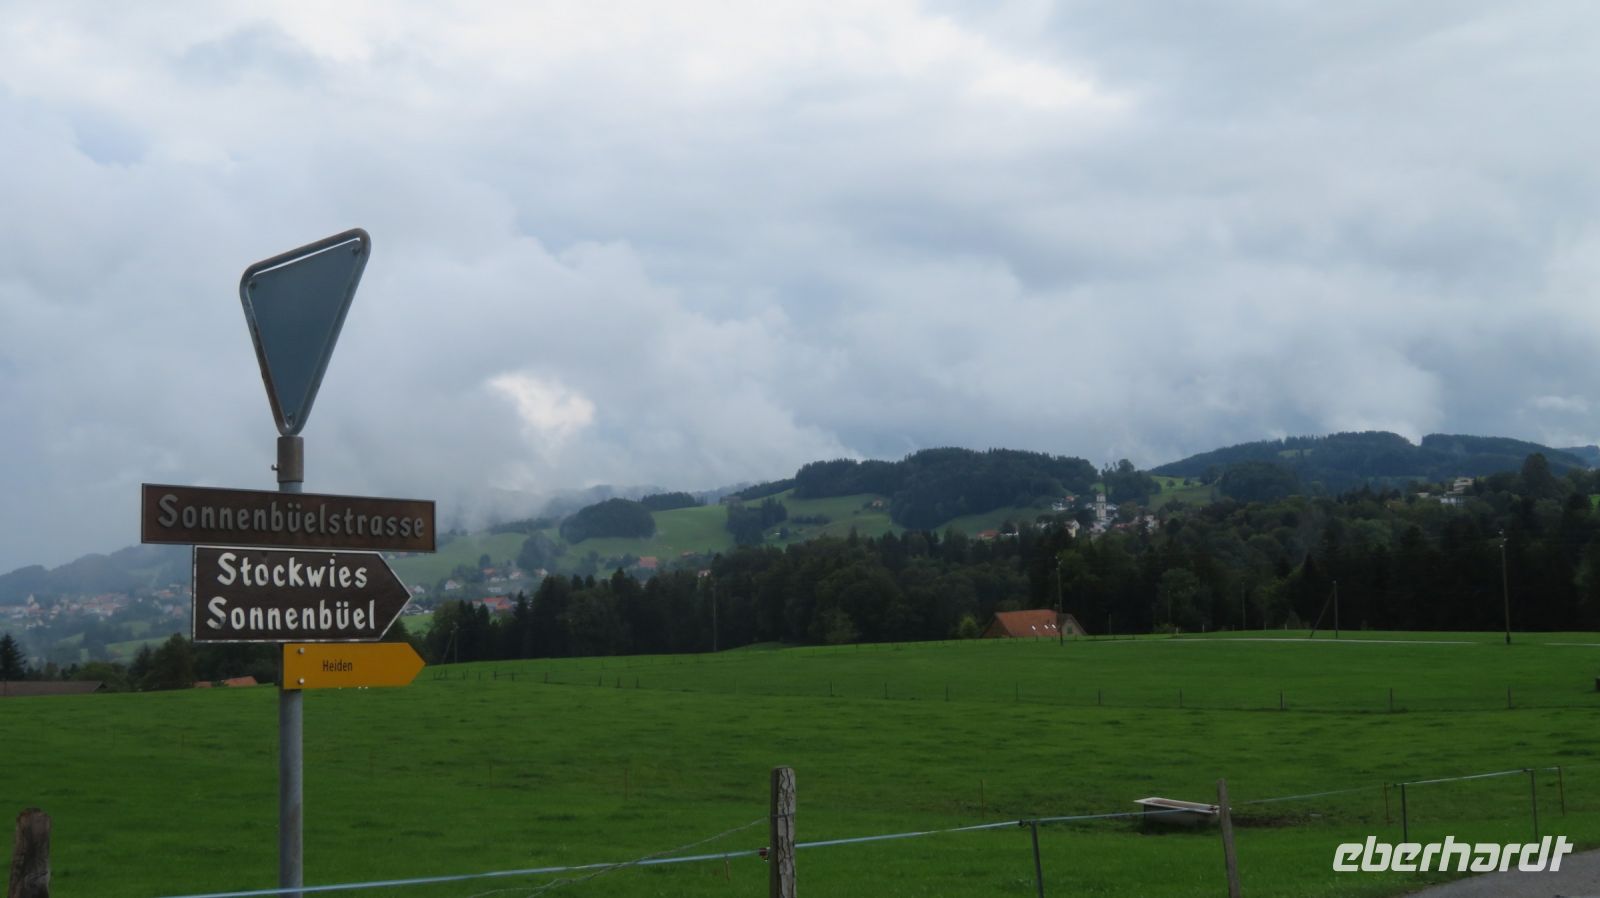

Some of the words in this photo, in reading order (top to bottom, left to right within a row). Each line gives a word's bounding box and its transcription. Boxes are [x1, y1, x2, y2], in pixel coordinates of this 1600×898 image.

[158, 494, 425, 538] Sonnenbüelstrasse
[217, 552, 368, 588] Stockwies
[207, 596, 375, 630] Sonnenbüel
[322, 659, 353, 672] Heiden
